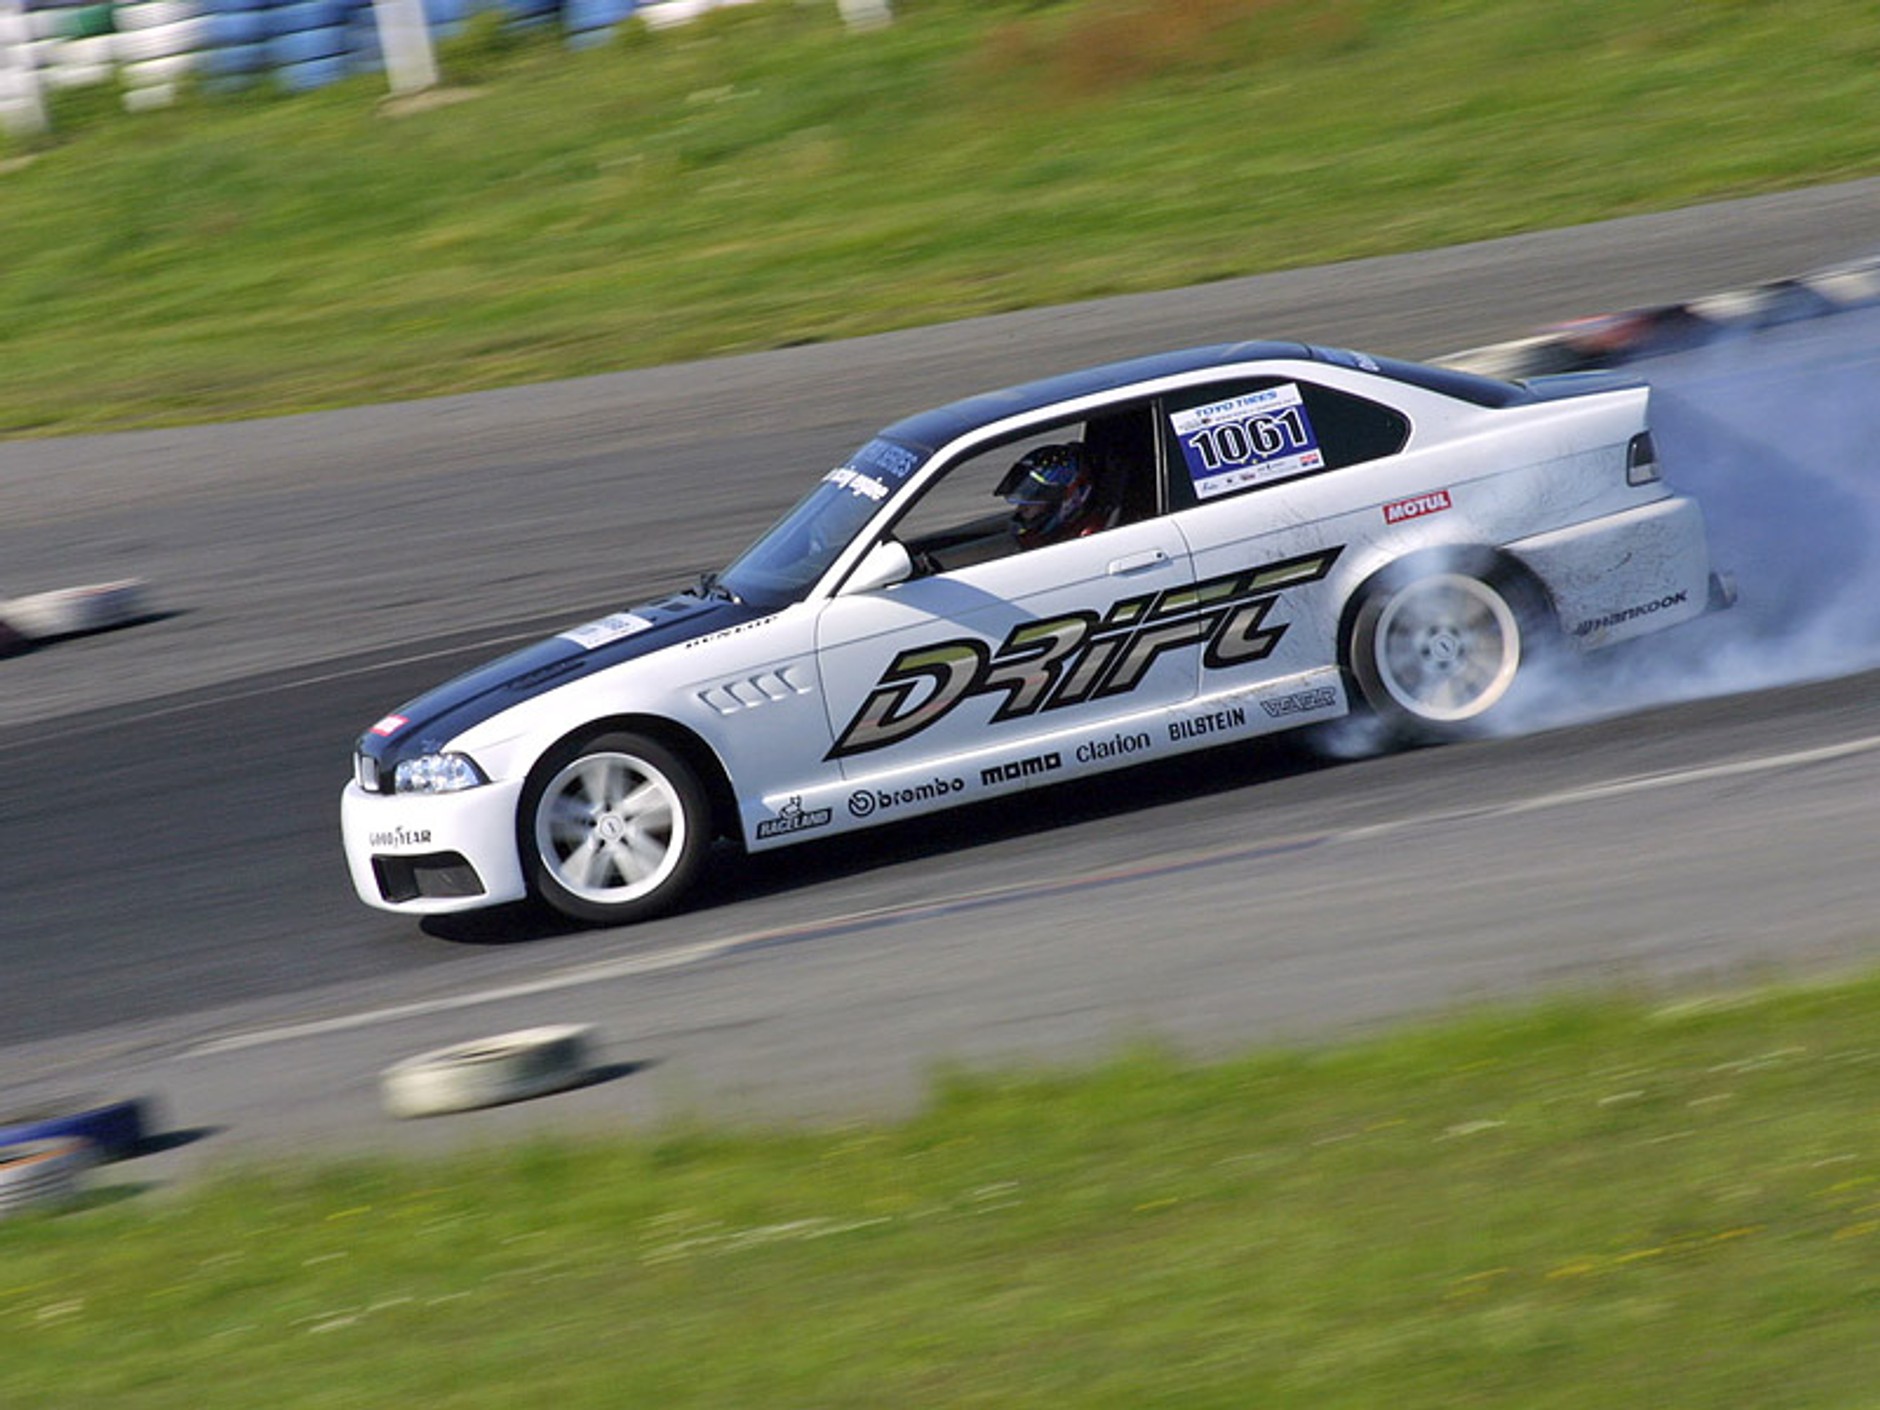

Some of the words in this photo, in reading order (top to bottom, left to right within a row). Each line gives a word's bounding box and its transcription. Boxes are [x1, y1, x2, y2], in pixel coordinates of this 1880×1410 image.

[1195, 401, 1234, 416] TOYO
[1189, 407, 1308, 470] 1061
[1388, 493, 1448, 521] MOTUL
[822, 544, 1347, 762] DRIFT
[1167, 707, 1246, 742] BILSTEIN
[759, 809, 829, 836] RACELAND
